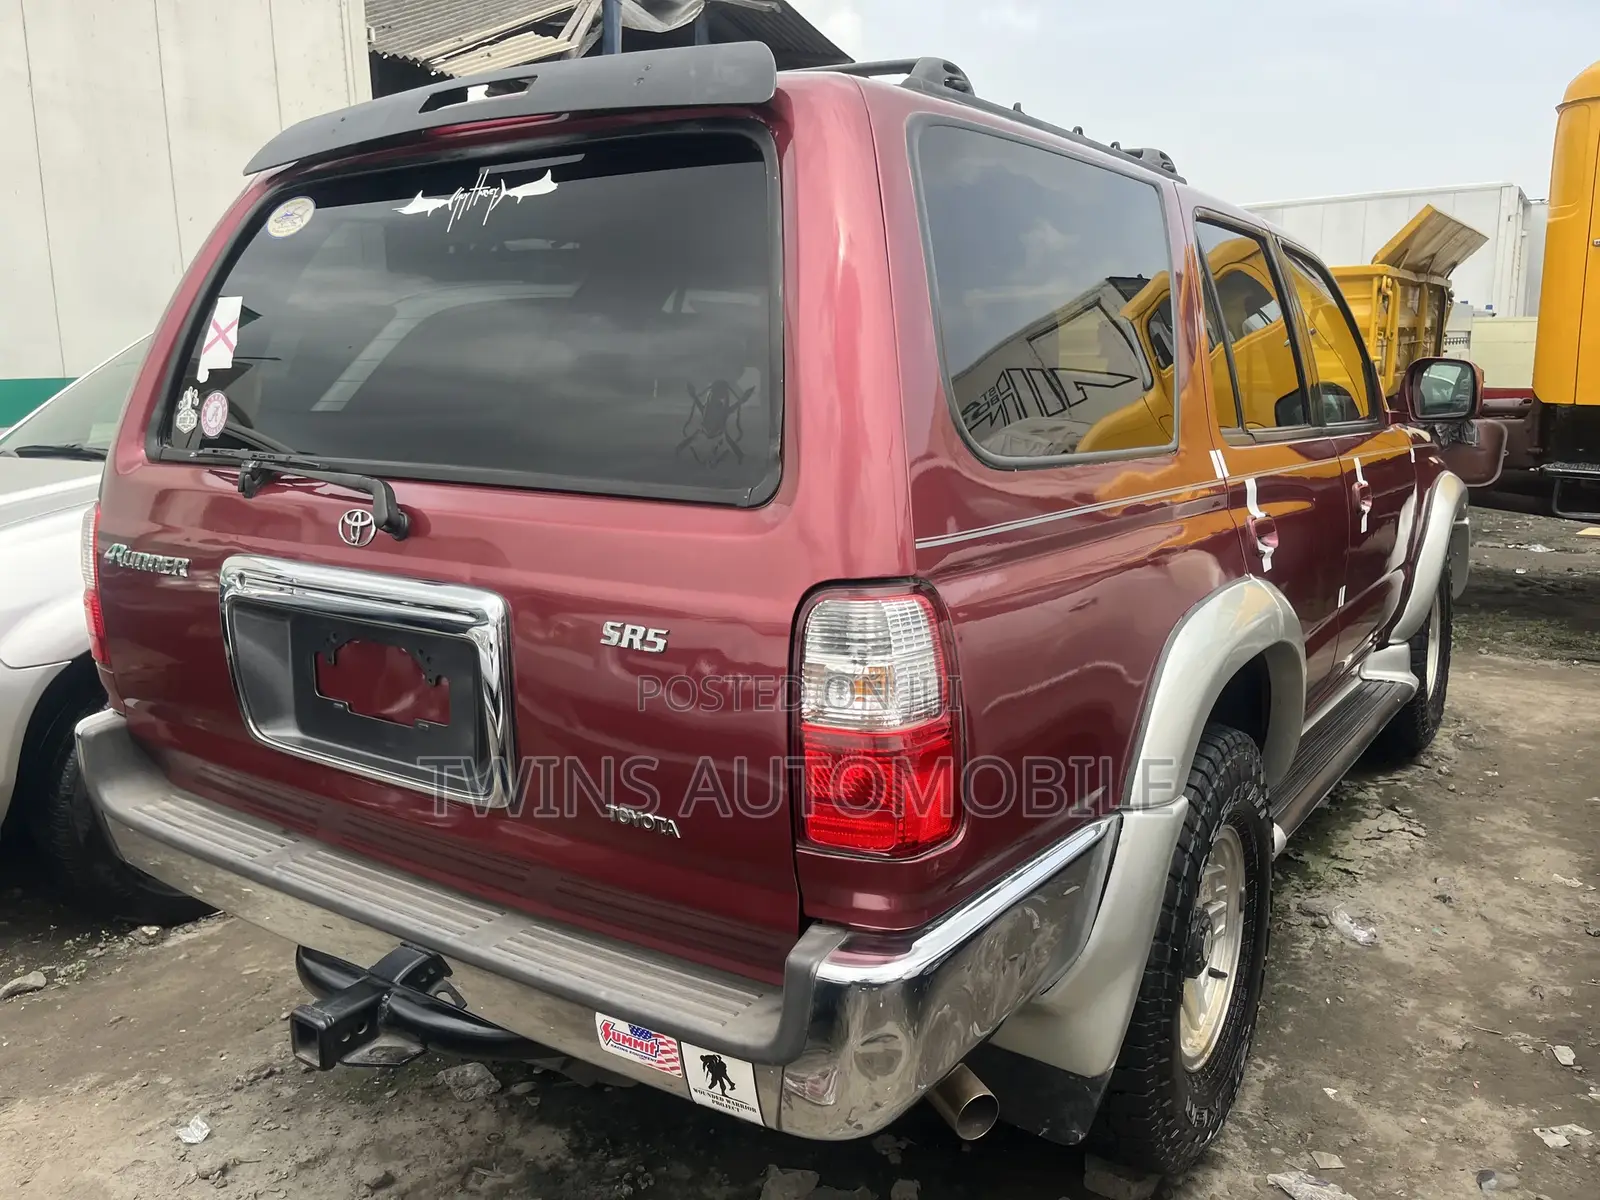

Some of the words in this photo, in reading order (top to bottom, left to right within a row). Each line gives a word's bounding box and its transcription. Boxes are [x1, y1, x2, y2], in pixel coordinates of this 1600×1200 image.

[600, 620, 670, 653] SR5
[605, 803, 682, 840] TOYOTA
[725, 1098, 757, 1113] WARRIOR
